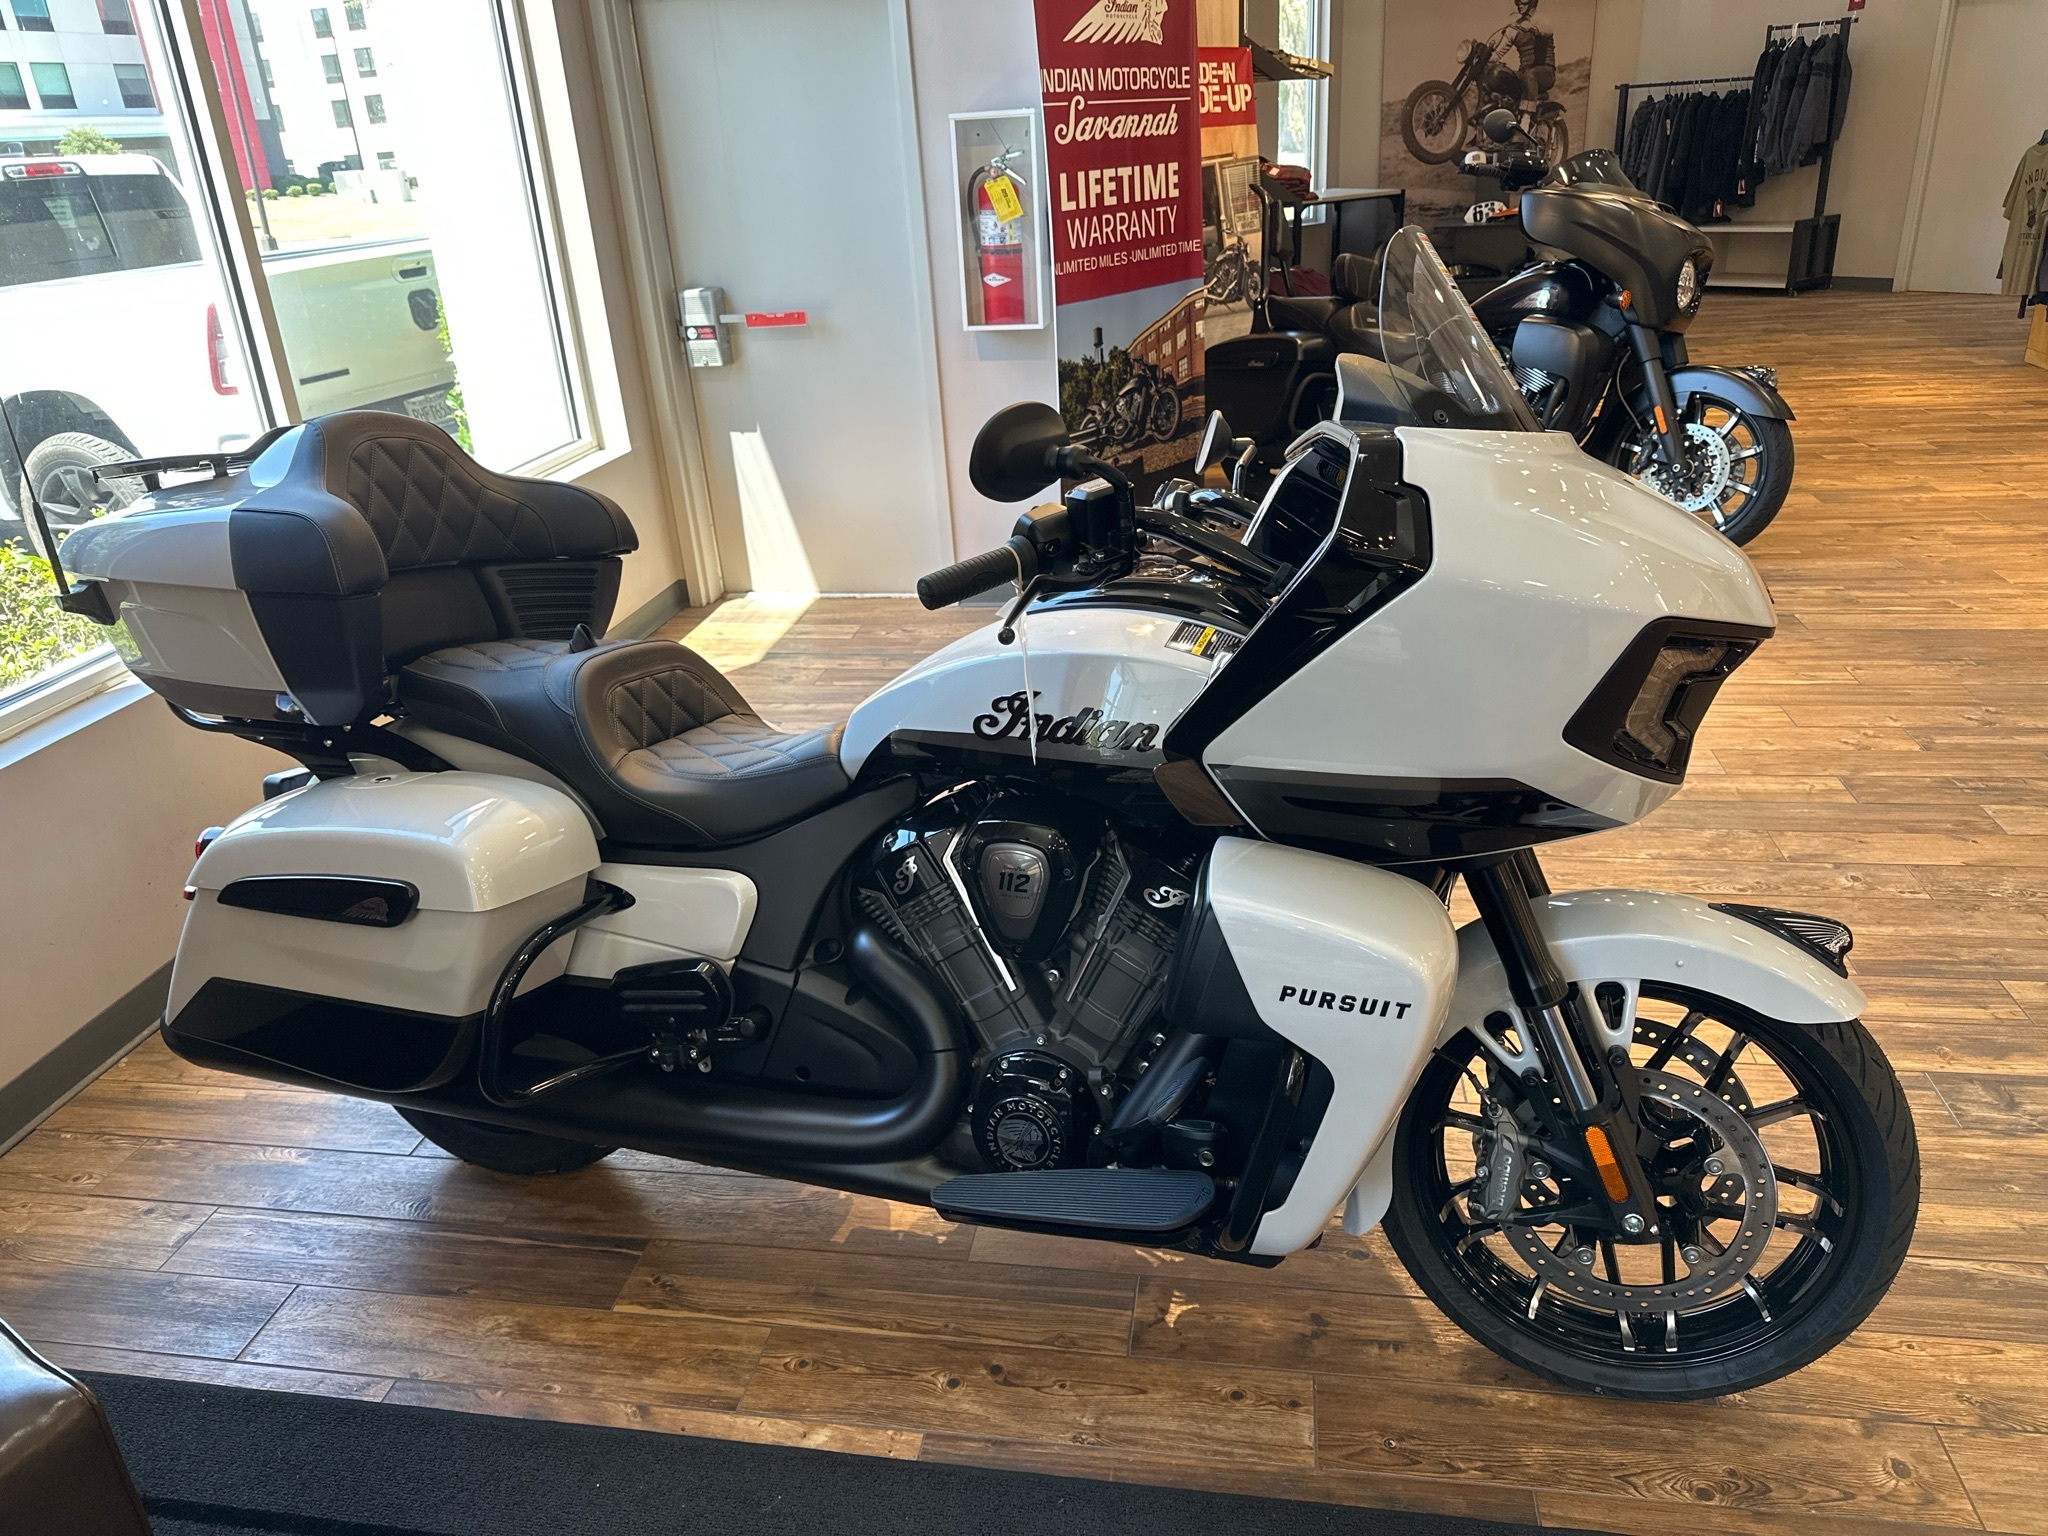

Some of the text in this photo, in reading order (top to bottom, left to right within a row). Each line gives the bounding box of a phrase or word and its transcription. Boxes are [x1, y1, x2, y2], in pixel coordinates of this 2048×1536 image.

[1040, 67, 1191, 93] INDIAN MOTORCYCLE
[1199, 62, 1236, 84] DE-IN
[1054, 95, 1179, 145] Savannah
[1059, 161, 1180, 212] LIFETIME
[1066, 204, 1178, 250] WARRANTY
[1055, 256, 1098, 276] NLIMITED
[1099, 251, 1128, 268] MILES
[1178, 239, 1202, 254] TIME
[972, 690, 1160, 752] Indian
[998, 871, 1031, 894] 112
[1278, 984, 1412, 1020] PURSUIT
[986, 1101, 1061, 1169] INDIAN MOTORCYCLE
[1494, 1154, 1513, 1207] brembo
